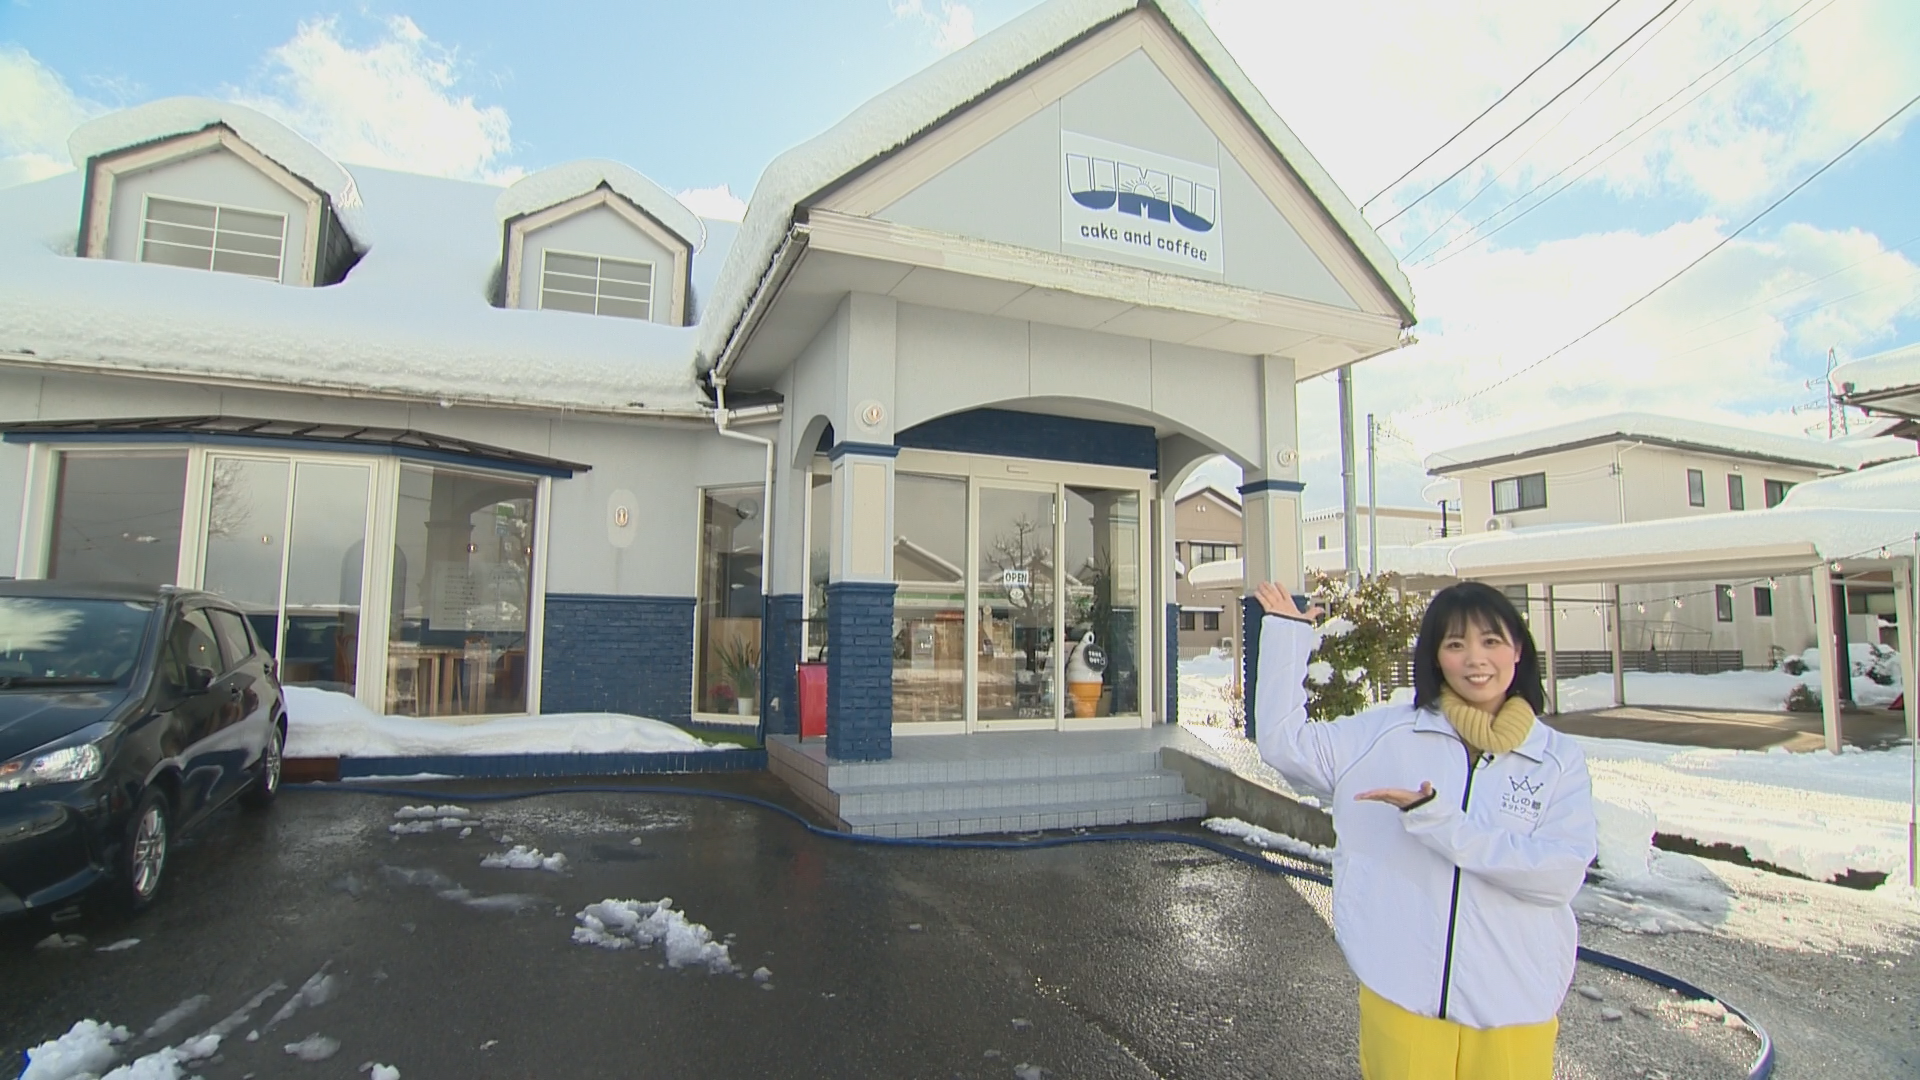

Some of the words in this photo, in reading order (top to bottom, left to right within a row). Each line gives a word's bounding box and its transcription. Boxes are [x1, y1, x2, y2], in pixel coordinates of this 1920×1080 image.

[1066, 153, 1216, 233] UMU
[1081, 223, 1118, 241] cake
[1124, 231, 1152, 247] and
[1157, 237, 1208, 262] coffee
[1005, 572, 1027, 583] OPEN
[1502, 801, 1539, 818] ネットワーク
